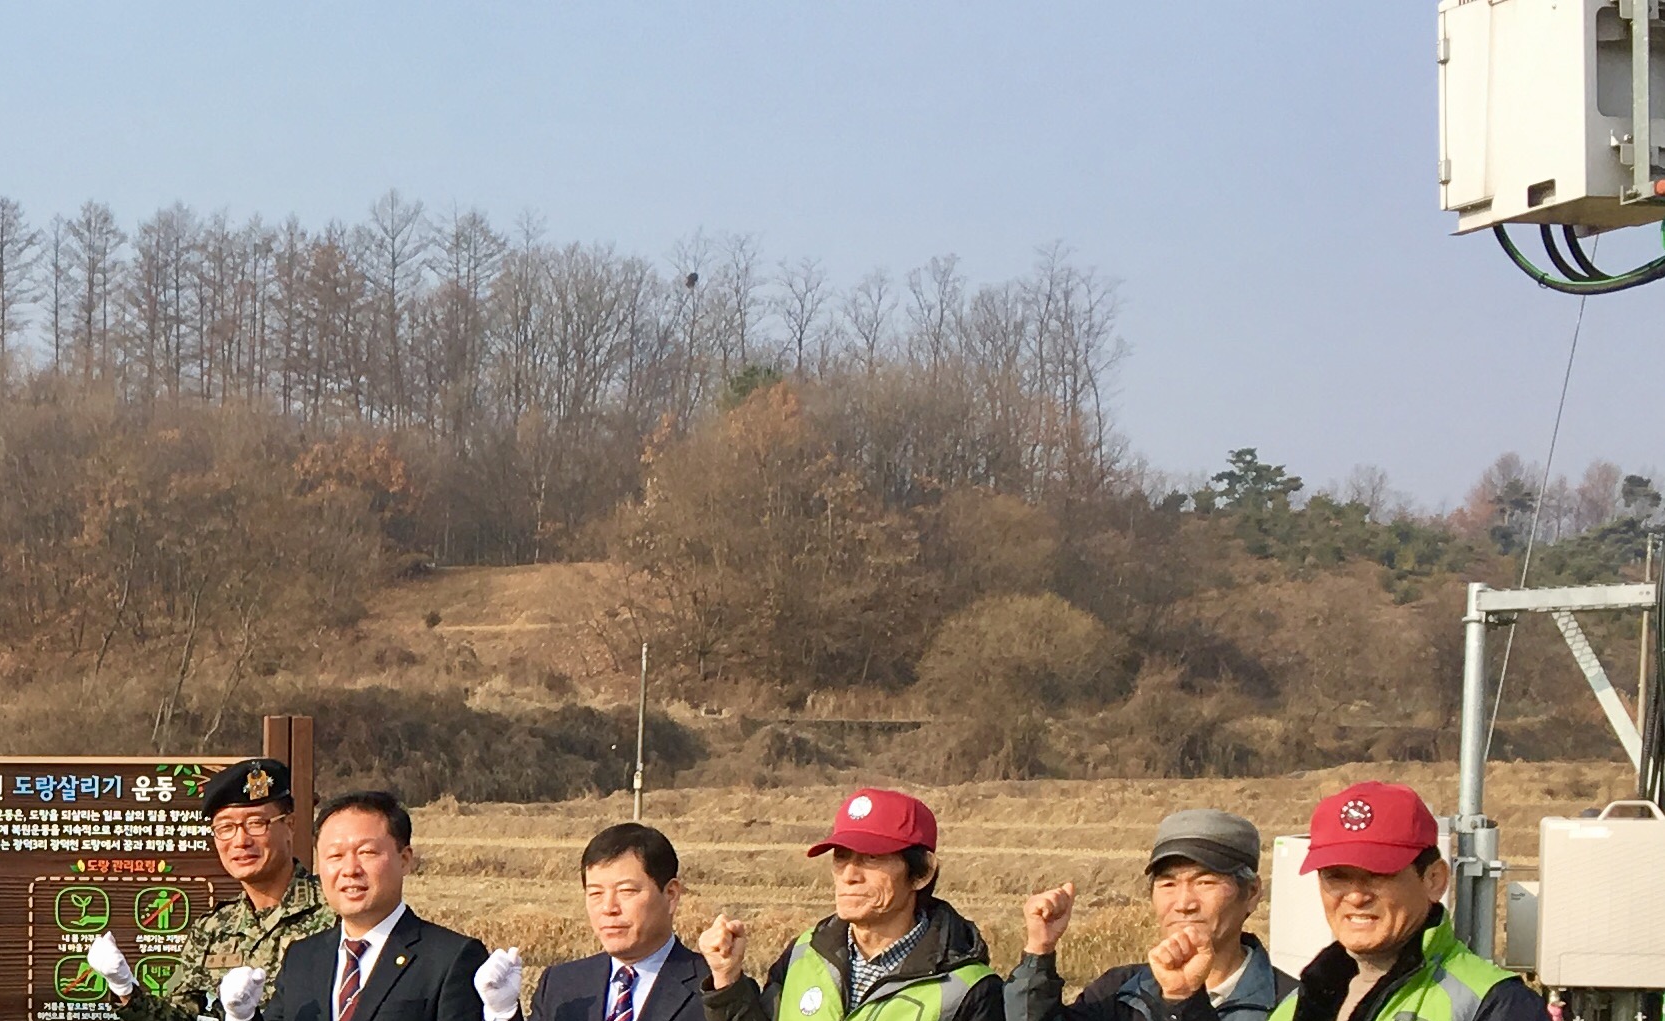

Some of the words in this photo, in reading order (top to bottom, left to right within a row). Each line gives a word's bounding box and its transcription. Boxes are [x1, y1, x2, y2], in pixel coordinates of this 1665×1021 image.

[13, 775, 123, 801] 도랑살리기
[131, 776, 177, 801] 운동
[29, 809, 58, 822] 도랑을
[61, 809, 100, 822] 되살리는
[124, 809, 144, 822] 삶의
[170, 809, 212, 822] 향상시
[11, 824, 60, 837] 복원운동을
[62, 824, 111, 837] 지속적으로
[113, 824, 152, 837] 추진하여
[13, 839, 47, 851] 광덕3리
[49, 839, 79, 851] 광덕천
[81, 839, 121, 851] 도랑에서
[145, 839, 175, 851] 희망을
[87, 859, 110, 873] 도랑
[112, 859, 156, 873] 관리요령
[150, 966, 171, 978] 비료
